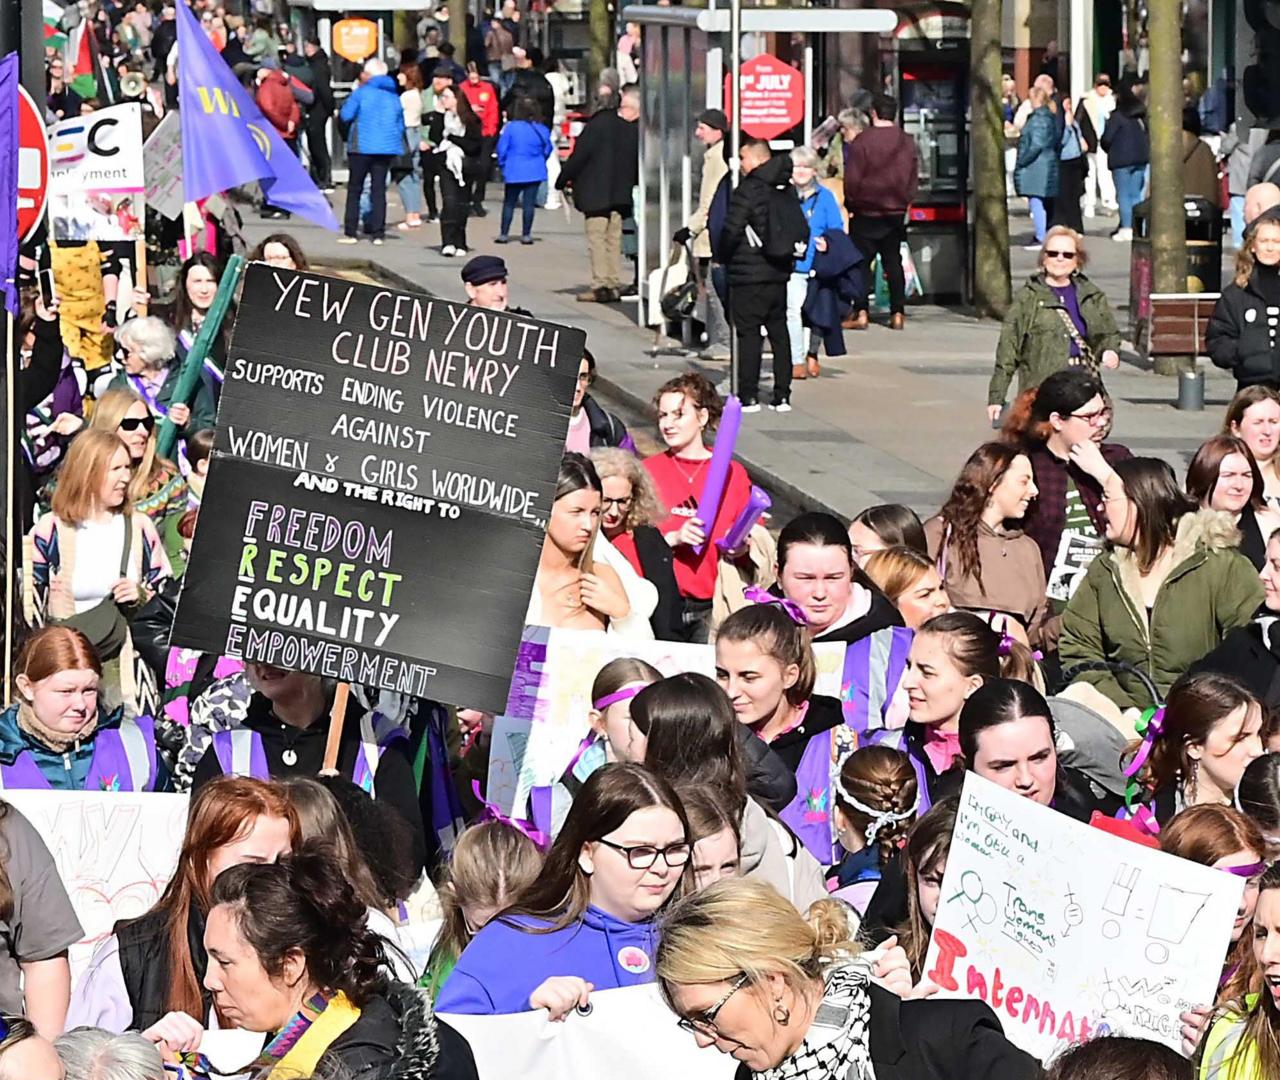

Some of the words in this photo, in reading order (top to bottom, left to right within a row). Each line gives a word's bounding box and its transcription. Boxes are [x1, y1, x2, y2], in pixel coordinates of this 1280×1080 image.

[756, 75, 791, 90] JULY
[272, 271, 355, 325] YEW
[369, 291, 433, 342] GEN
[447, 304, 561, 367] YOUTH
[331, 330, 411, 376] CLUB
[425, 349, 520, 397] NEWRY
[231, 358, 324, 395] SUPPORTS
[341, 377, 404, 413] ENDING
[423, 395, 518, 438] VIOLENCE
[228, 426, 310, 470] WOMEN
[361, 455, 418, 491] GIRLS
[331, 413, 431, 454] AGAINST
[293, 472, 338, 495] AND
[344, 481, 379, 502] THE
[381, 489, 435, 516] RIGHT
[438, 502, 461, 520] TO
[245, 501, 394, 568] FREEDOM
[239, 543, 403, 607] RESPECT
[231, 585, 400, 647] EQUALITY
[224, 624, 437, 697] EMPOWERMENT
[1012, 828, 1039, 852] and
[1003, 881, 1045, 925] Trans
